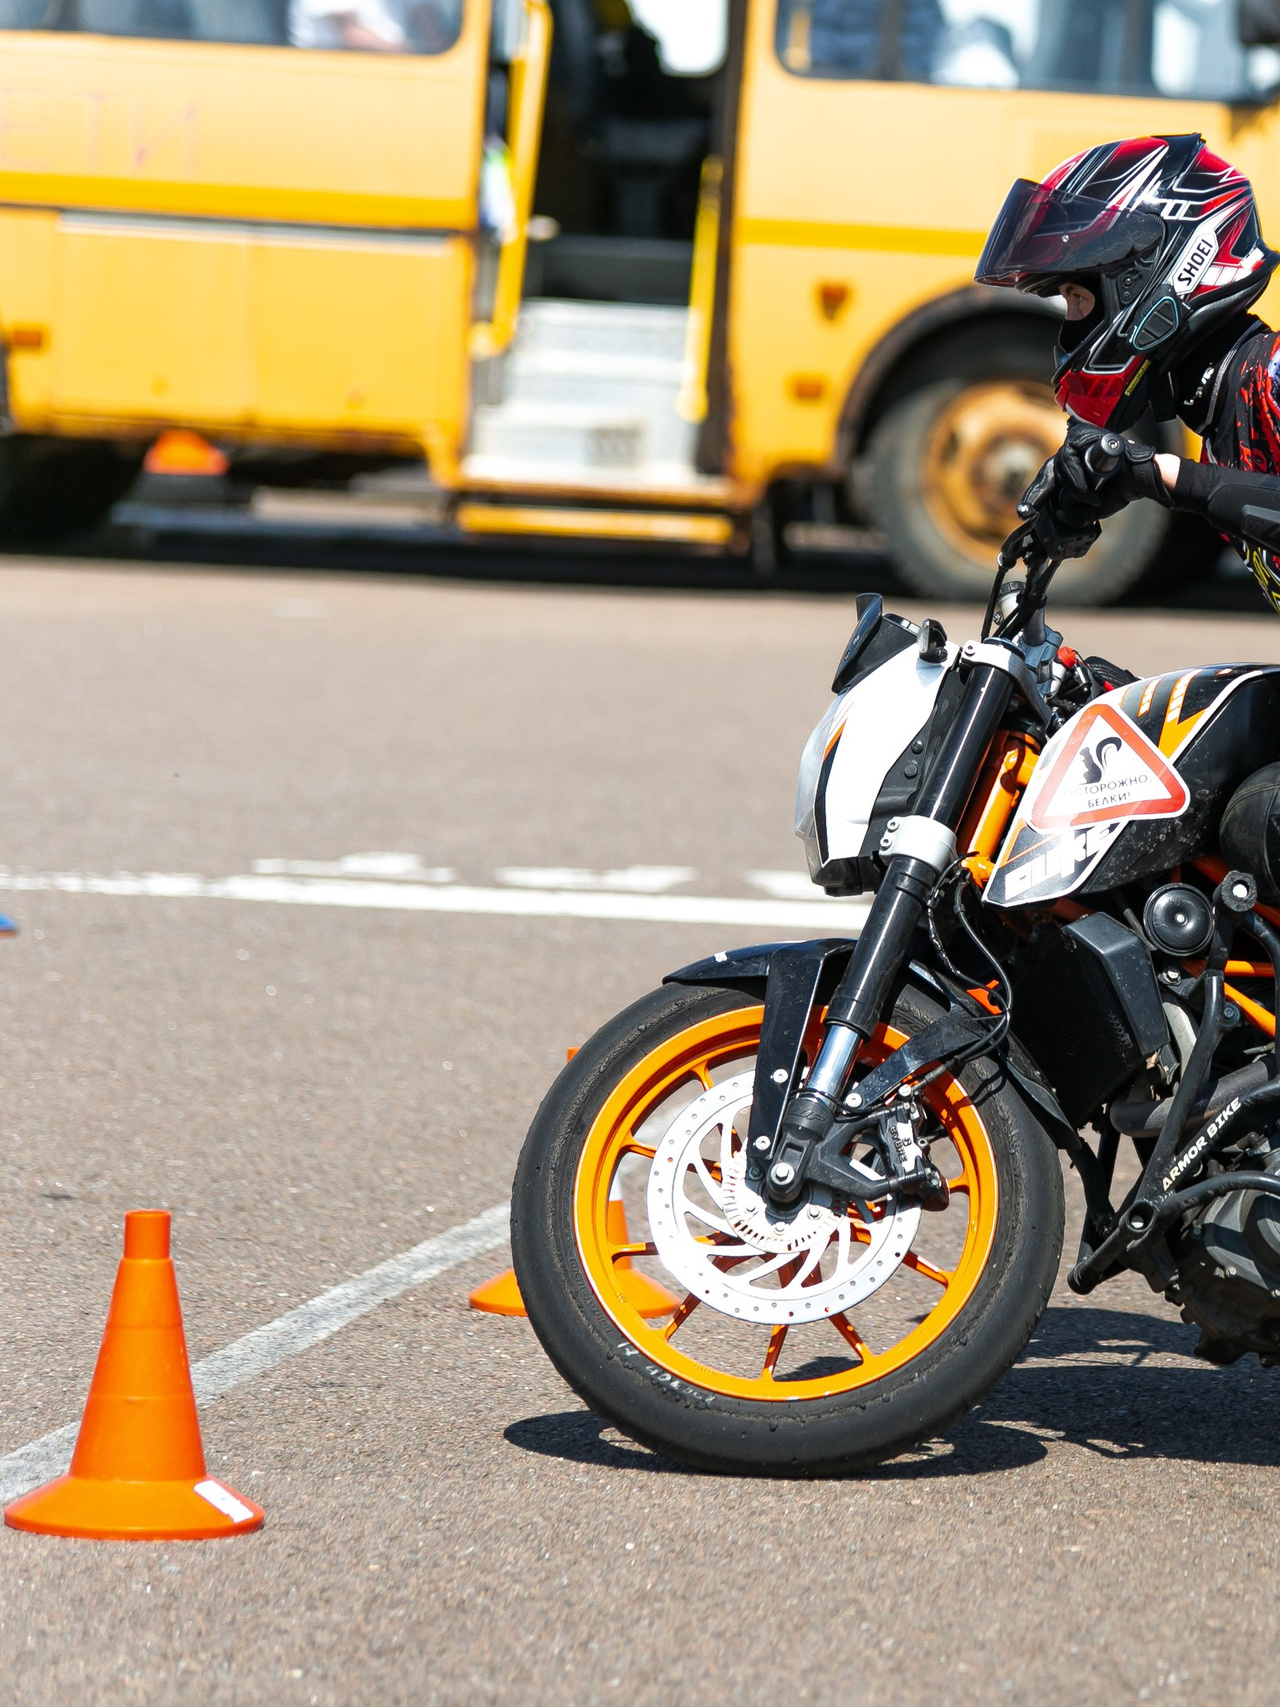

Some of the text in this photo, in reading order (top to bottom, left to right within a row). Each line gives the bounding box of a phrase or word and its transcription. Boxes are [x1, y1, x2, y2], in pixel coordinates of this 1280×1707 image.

[1177, 239, 1214, 286] SHOEI
[1088, 791, 1131, 808] БЕЛКИ!
[1162, 1096, 1242, 1191] ARMOR BIKE
